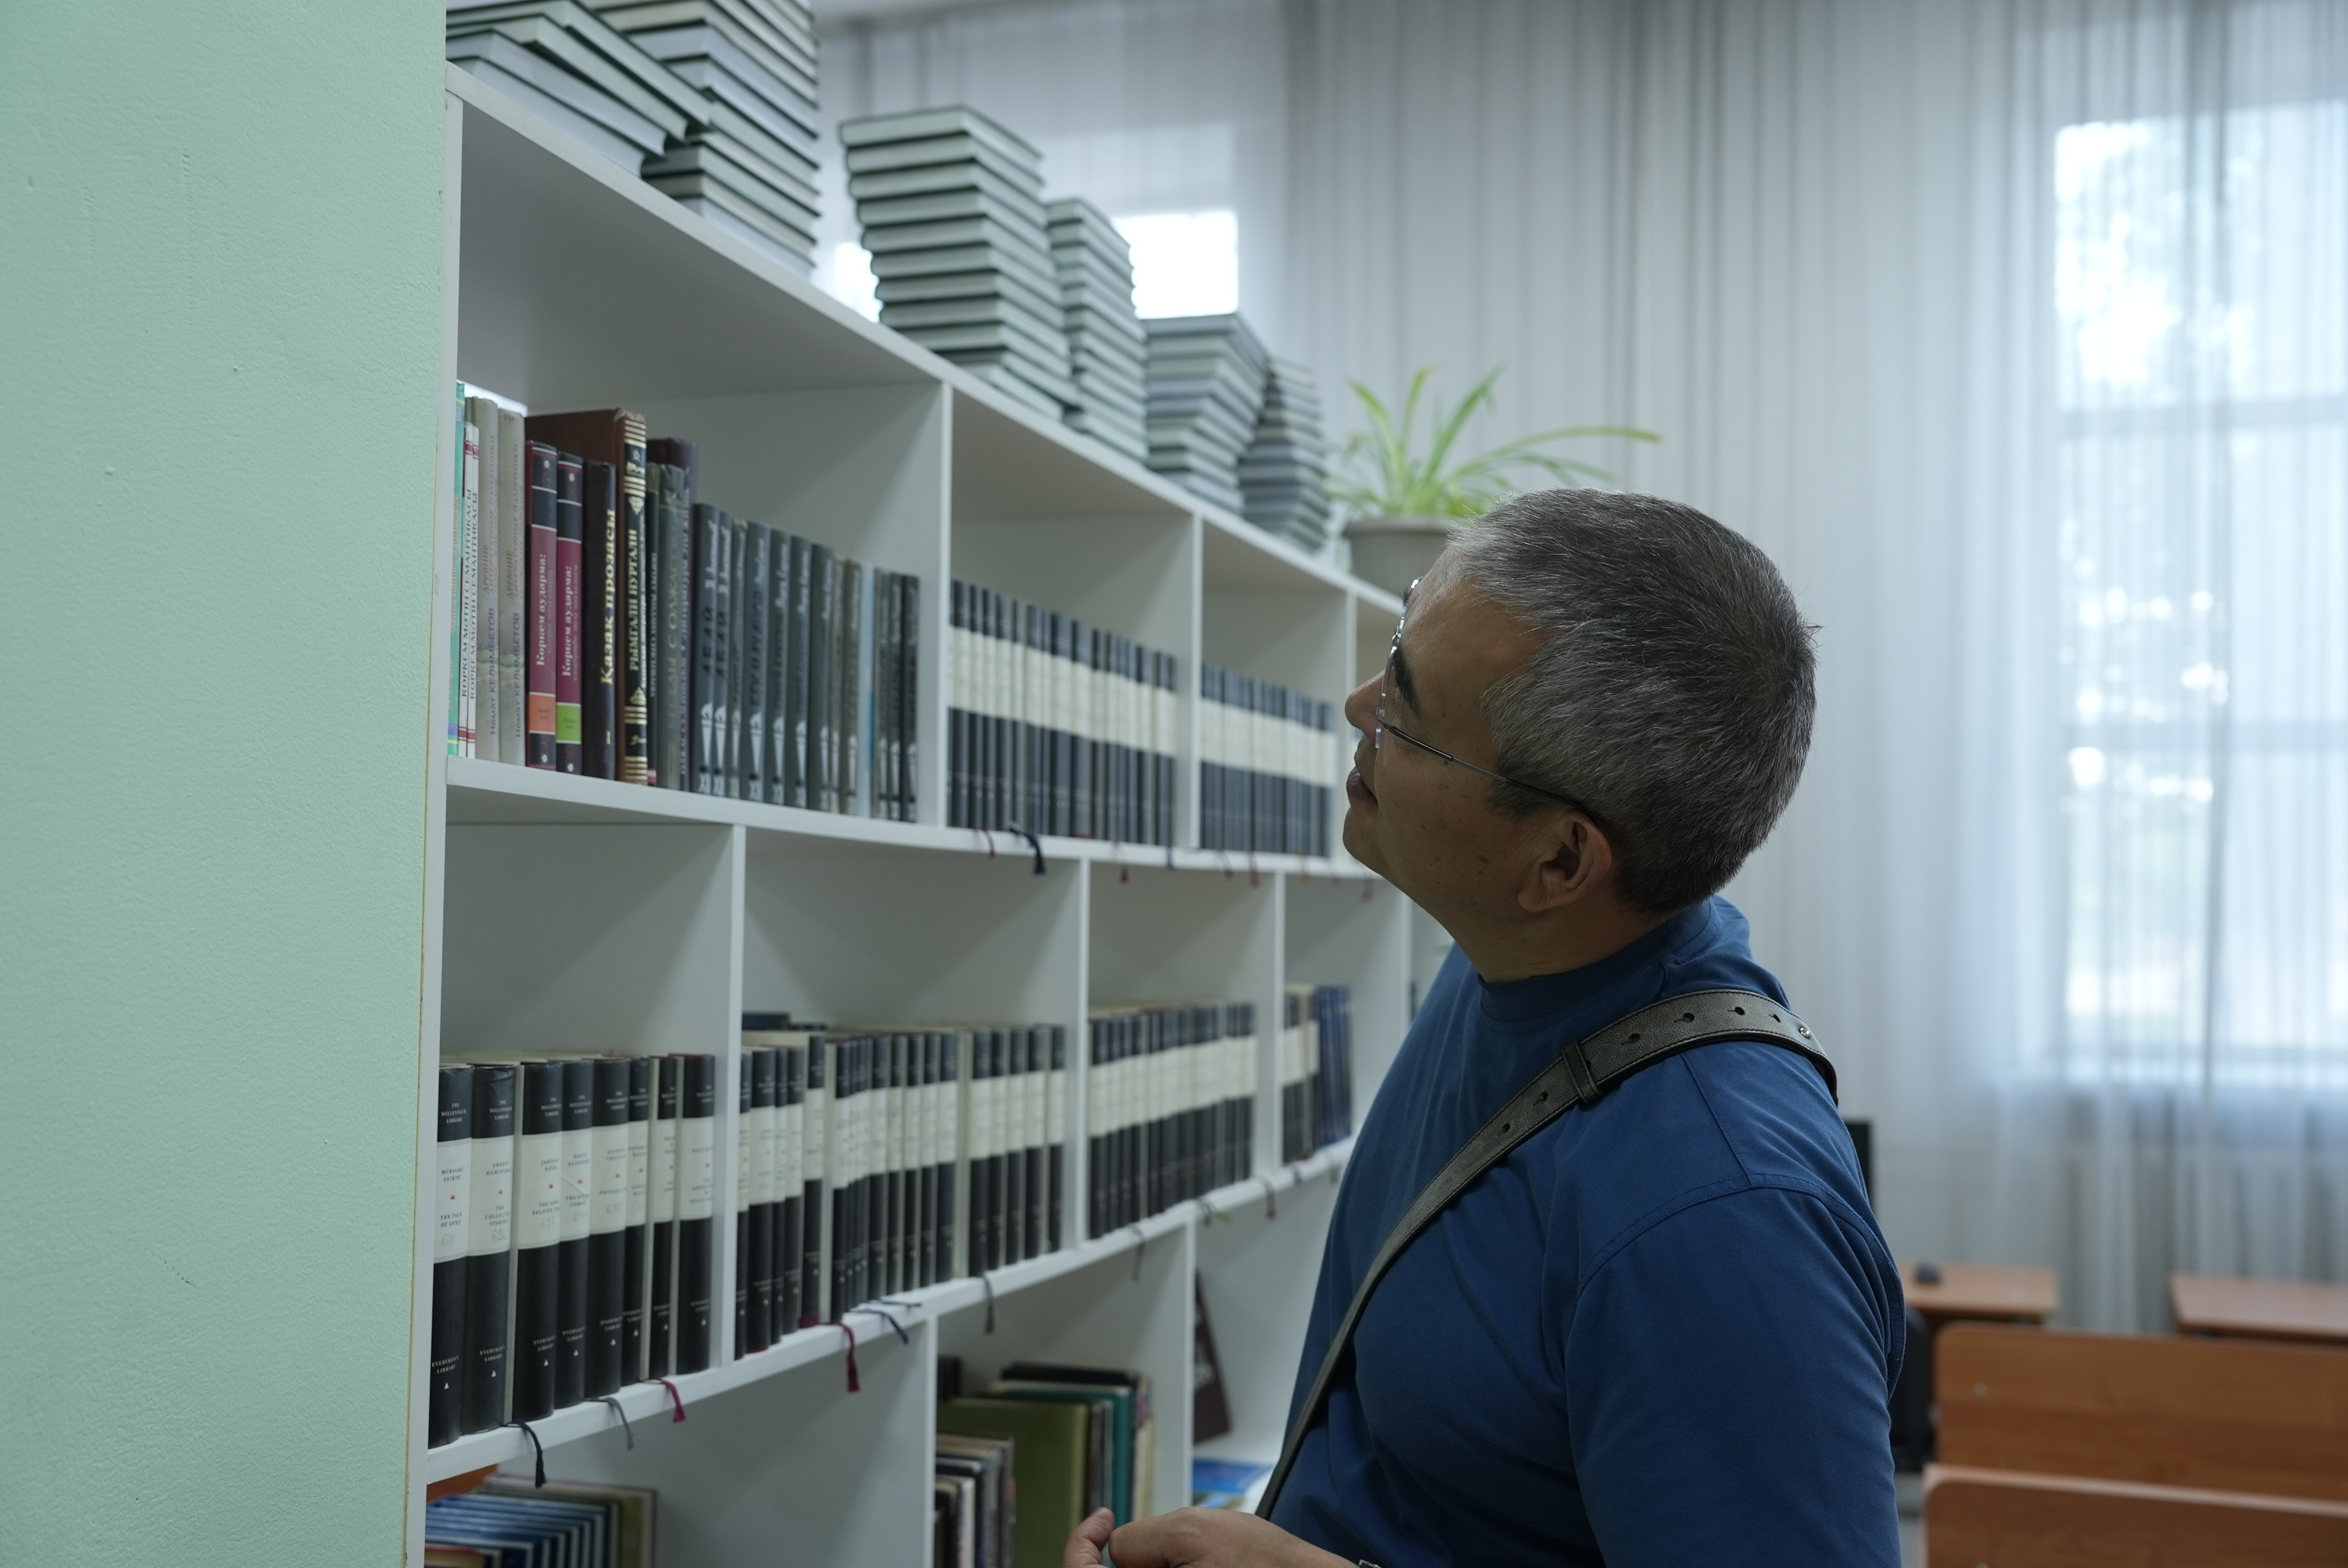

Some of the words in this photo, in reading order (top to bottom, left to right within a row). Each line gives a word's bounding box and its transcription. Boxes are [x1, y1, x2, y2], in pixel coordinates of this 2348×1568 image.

[604, 508, 616, 610] прозасы
[539, 553, 548, 613] аударма:
[565, 566, 574, 624] аударма:
[441, 1167, 464, 1175] MURASAKI
[437, 1364, 456, 1374] LIBRARY
[485, 1353, 503, 1363] LIBRARY
